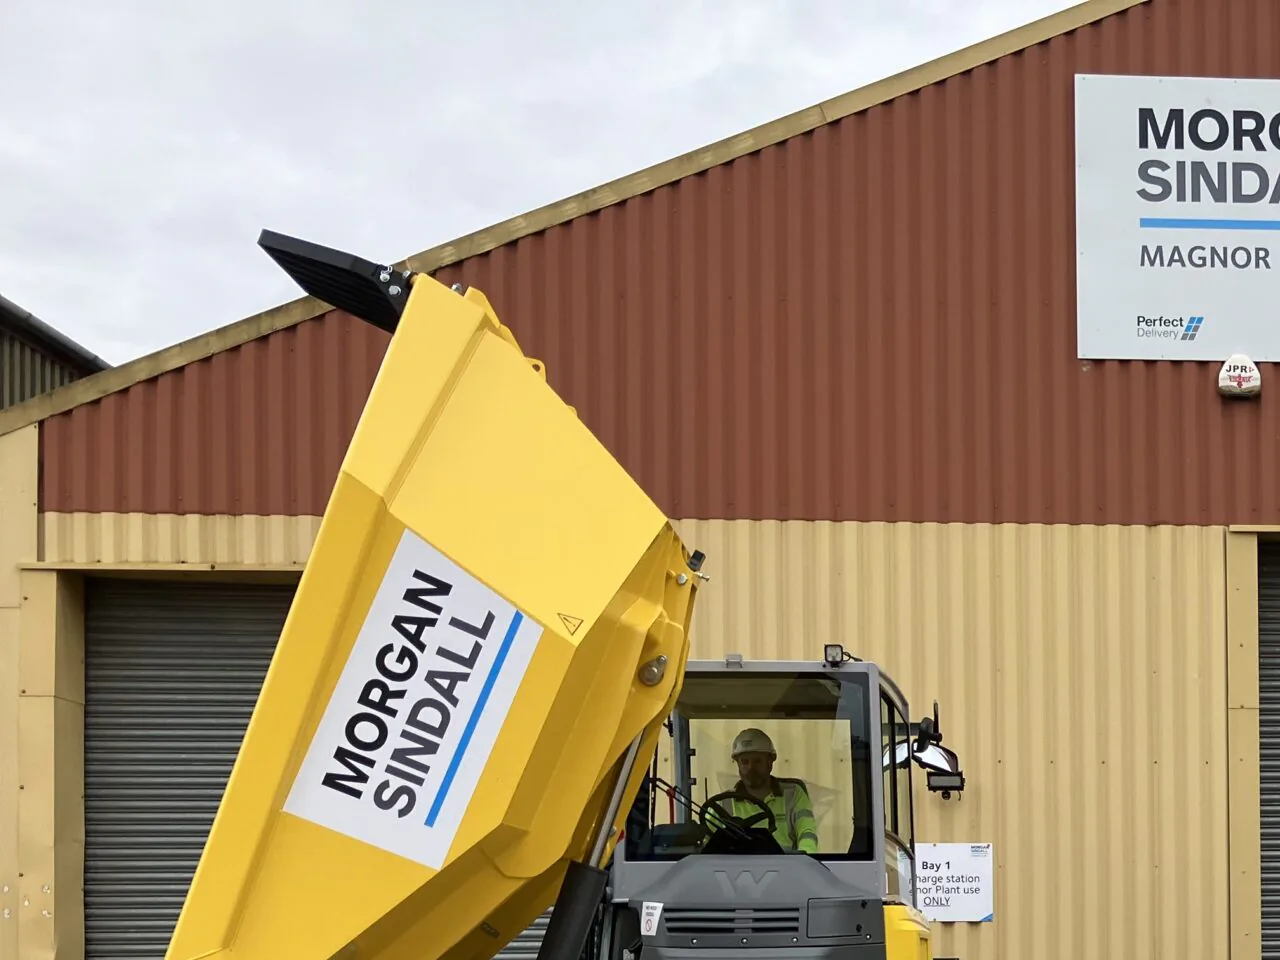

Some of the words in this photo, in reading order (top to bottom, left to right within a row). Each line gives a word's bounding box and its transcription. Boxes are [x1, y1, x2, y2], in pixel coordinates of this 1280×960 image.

[1139, 244, 1271, 269] MAGNOR
[1137, 315, 1184, 327] Perfect
[1137, 327, 1179, 340] Delivery
[1225, 364, 1248, 373] JPR
[321, 568, 453, 800] MORGAN
[373, 609, 496, 819] SINDALL
[921, 861, 941, 872] Bay
[945, 861, 950, 870] 1
[915, 874, 943, 885] harge
[946, 874, 980, 883] station
[935, 885, 960, 894] Plant
[923, 896, 951, 906] ONLY
